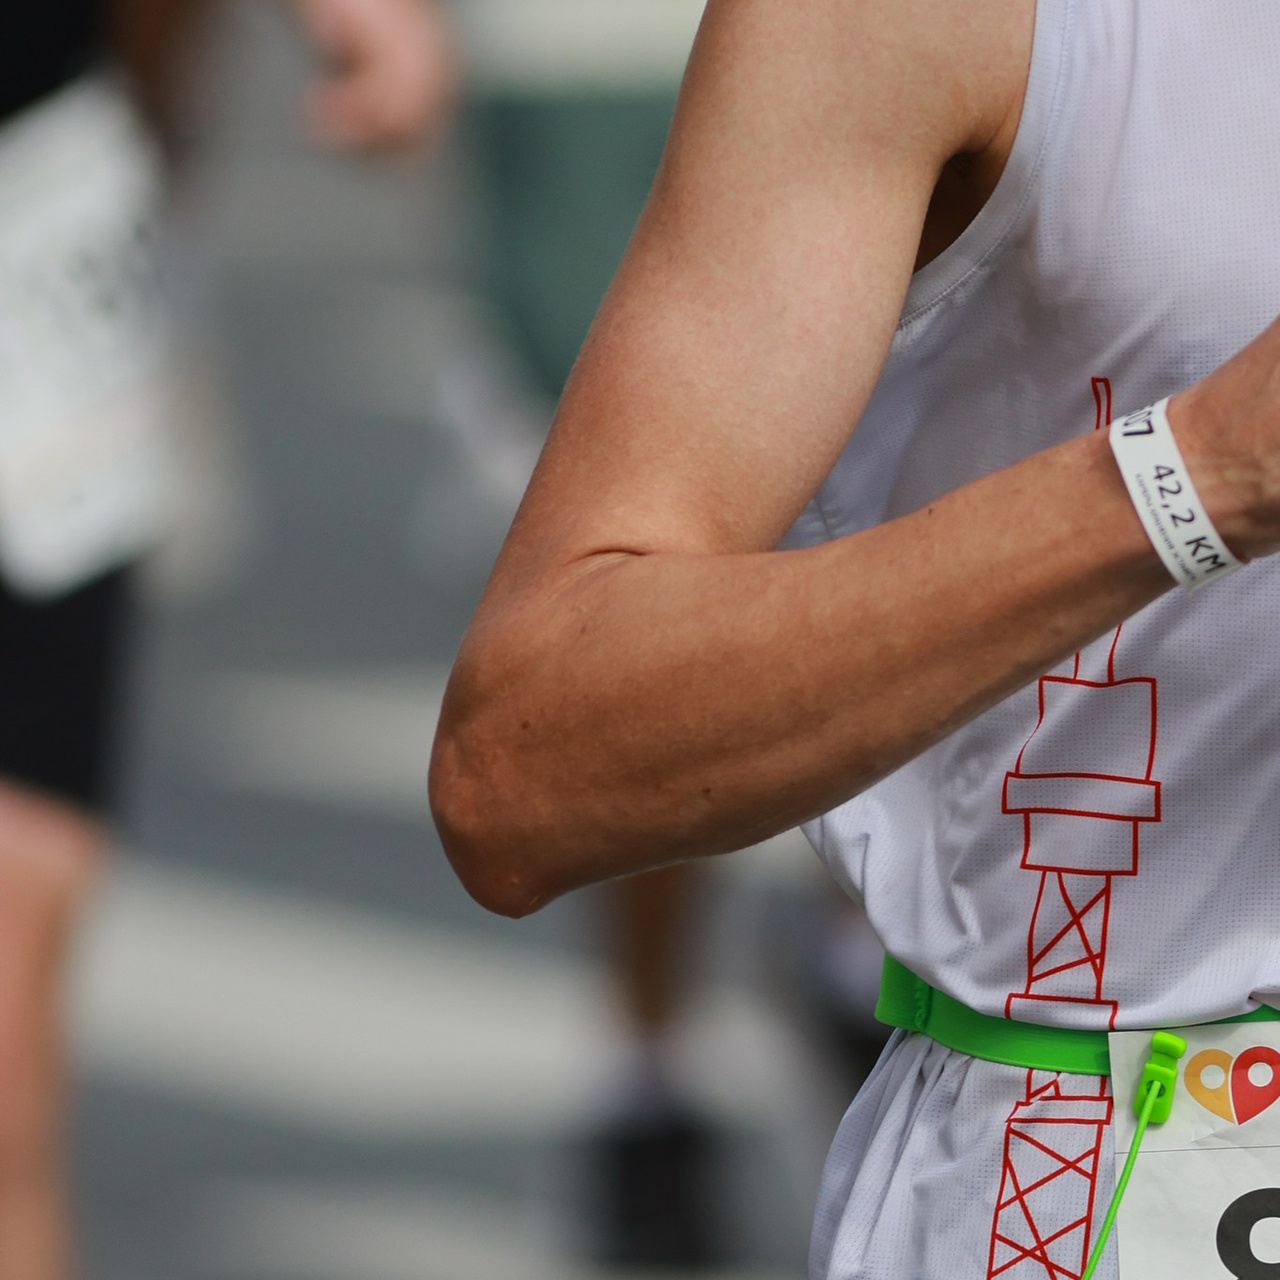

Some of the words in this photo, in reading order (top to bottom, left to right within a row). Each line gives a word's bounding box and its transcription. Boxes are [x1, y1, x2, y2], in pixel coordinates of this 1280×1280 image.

[1122, 406, 1155, 437] 07
[1153, 464, 1196, 528] 42,2
[1185, 536, 1227, 574] КМ
